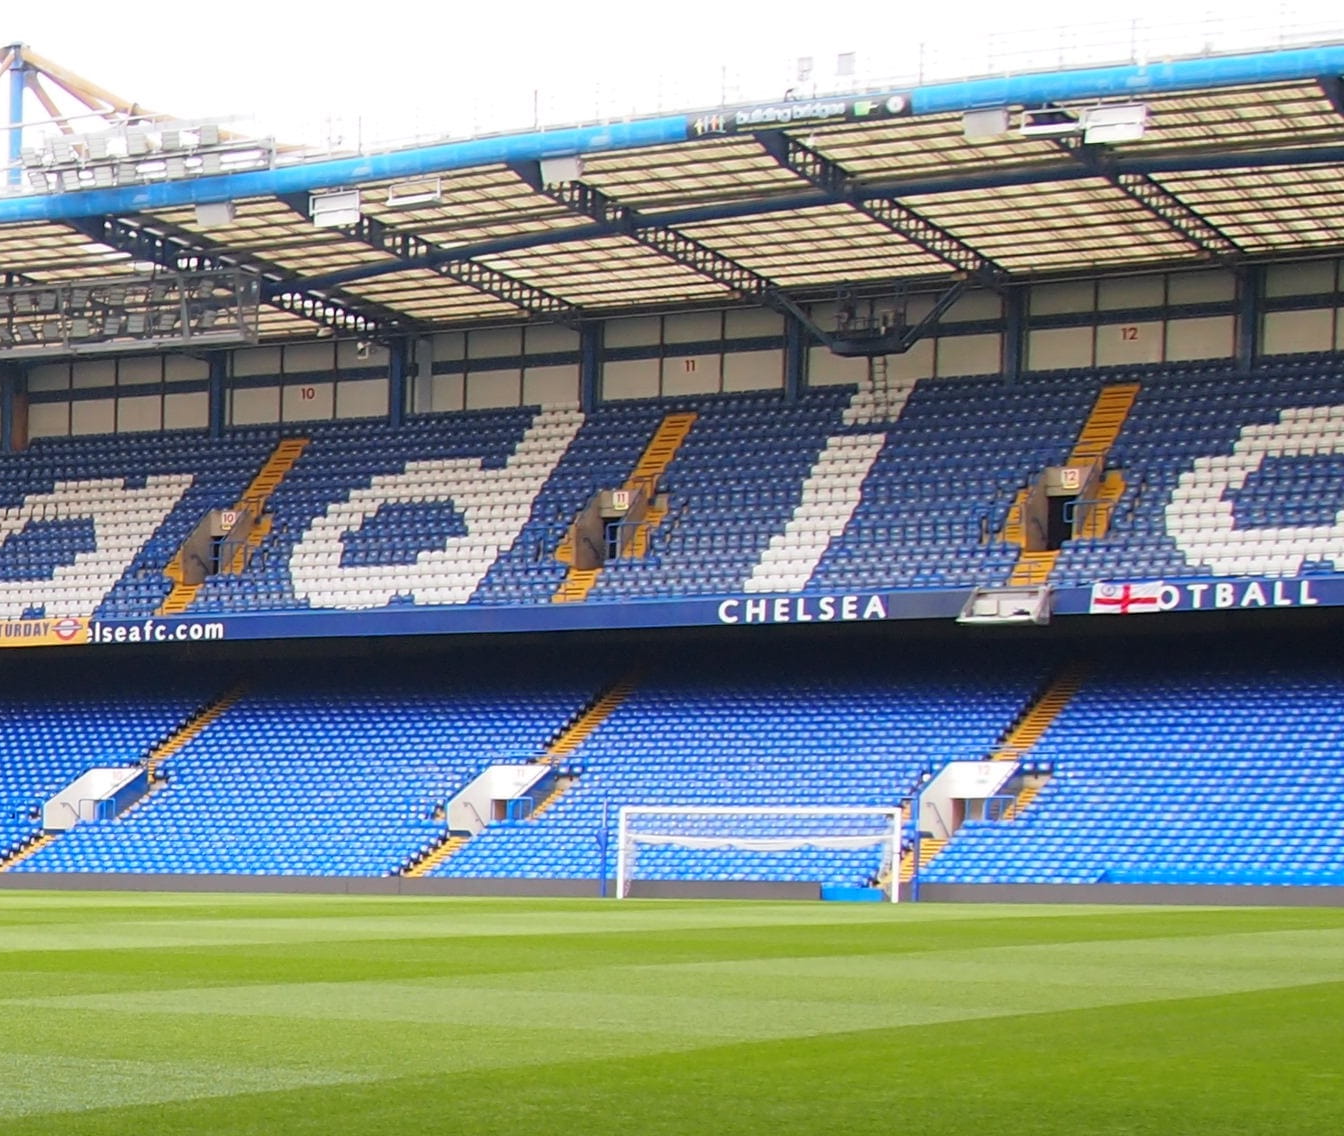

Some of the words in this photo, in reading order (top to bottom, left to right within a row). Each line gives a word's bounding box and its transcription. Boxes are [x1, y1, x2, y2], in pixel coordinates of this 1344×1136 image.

[1121, 327, 1138, 341] 12
[685, 360, 696, 372] 11
[301, 387, 315, 400] 10
[1063, 471, 1076, 481] 12
[223, 513, 234, 523] 10
[1160, 580, 1318, 610] OTBALL
[718, 594, 887, 623] CHELSEA
[86, 620, 224, 643] elseafc.com
